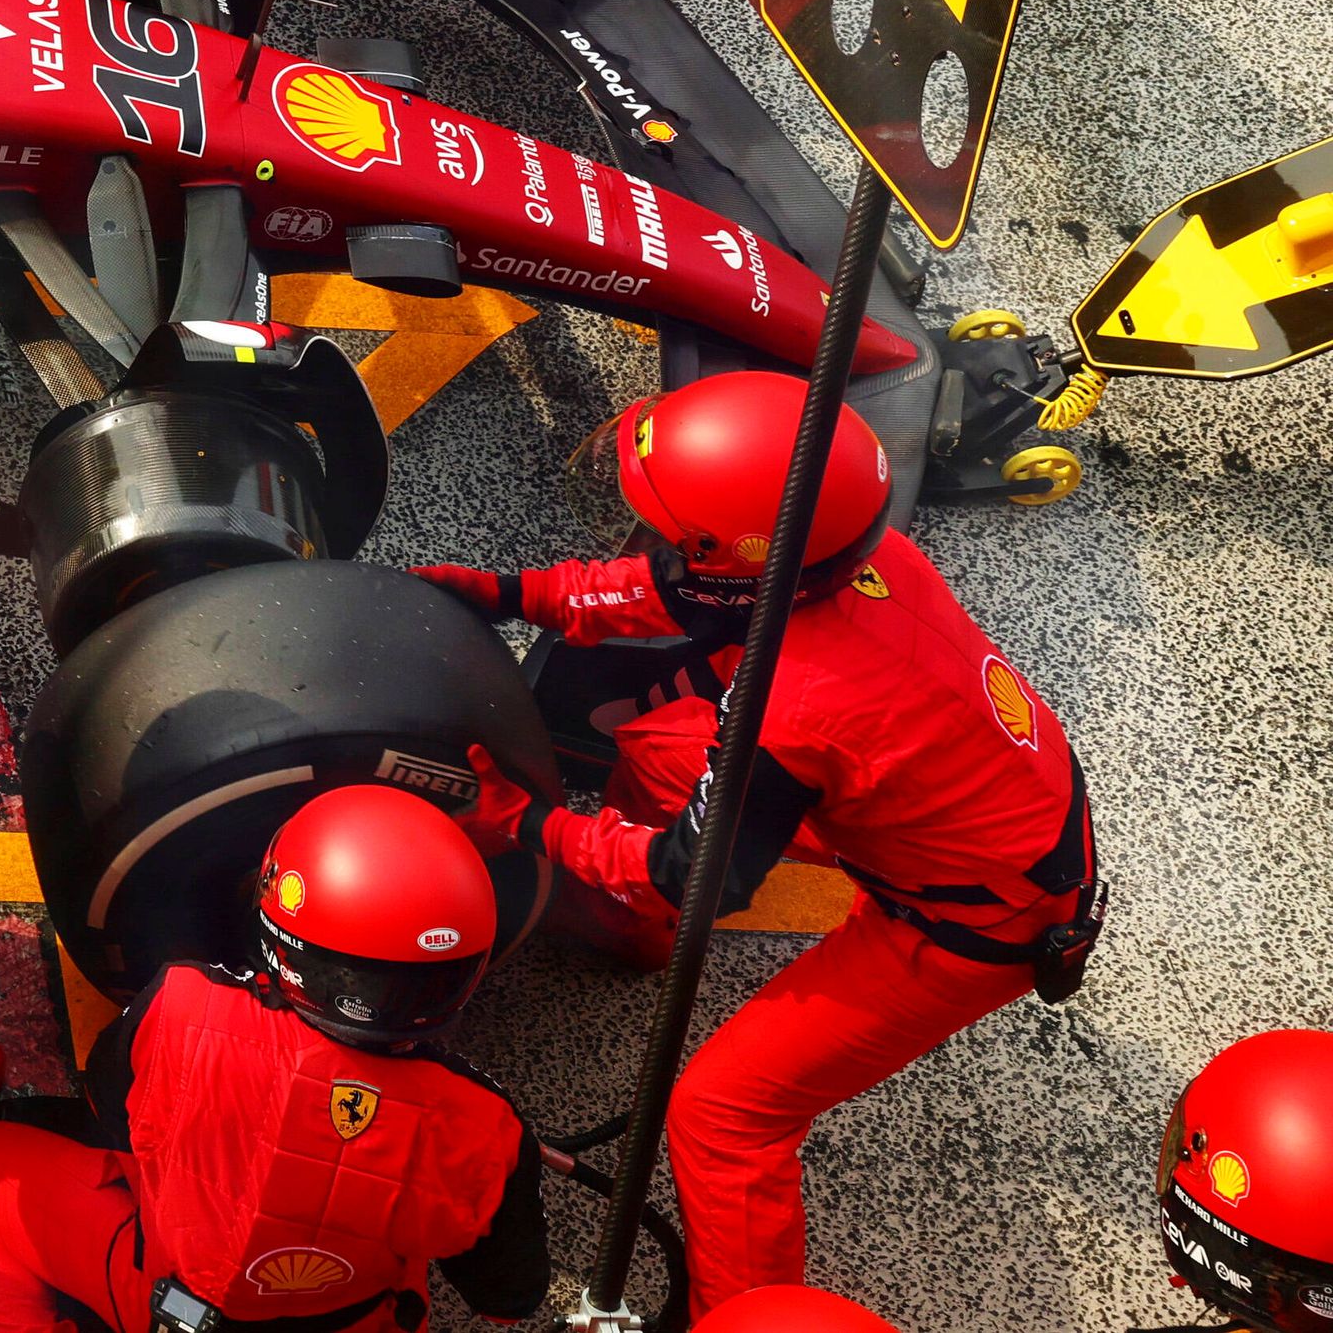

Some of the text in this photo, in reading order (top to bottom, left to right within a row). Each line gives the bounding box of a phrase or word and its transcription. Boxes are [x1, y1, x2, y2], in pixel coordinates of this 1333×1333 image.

[430, 117, 466, 180] aws
[580, 182, 605, 247] PIRELLI
[471, 246, 651, 297] Santander
[738, 224, 771, 318] Santande
[279, 928, 304, 951] MILLE
[424, 933, 455, 946] BELL
[1174, 1184, 1249, 1247] RICHARD MILLE
